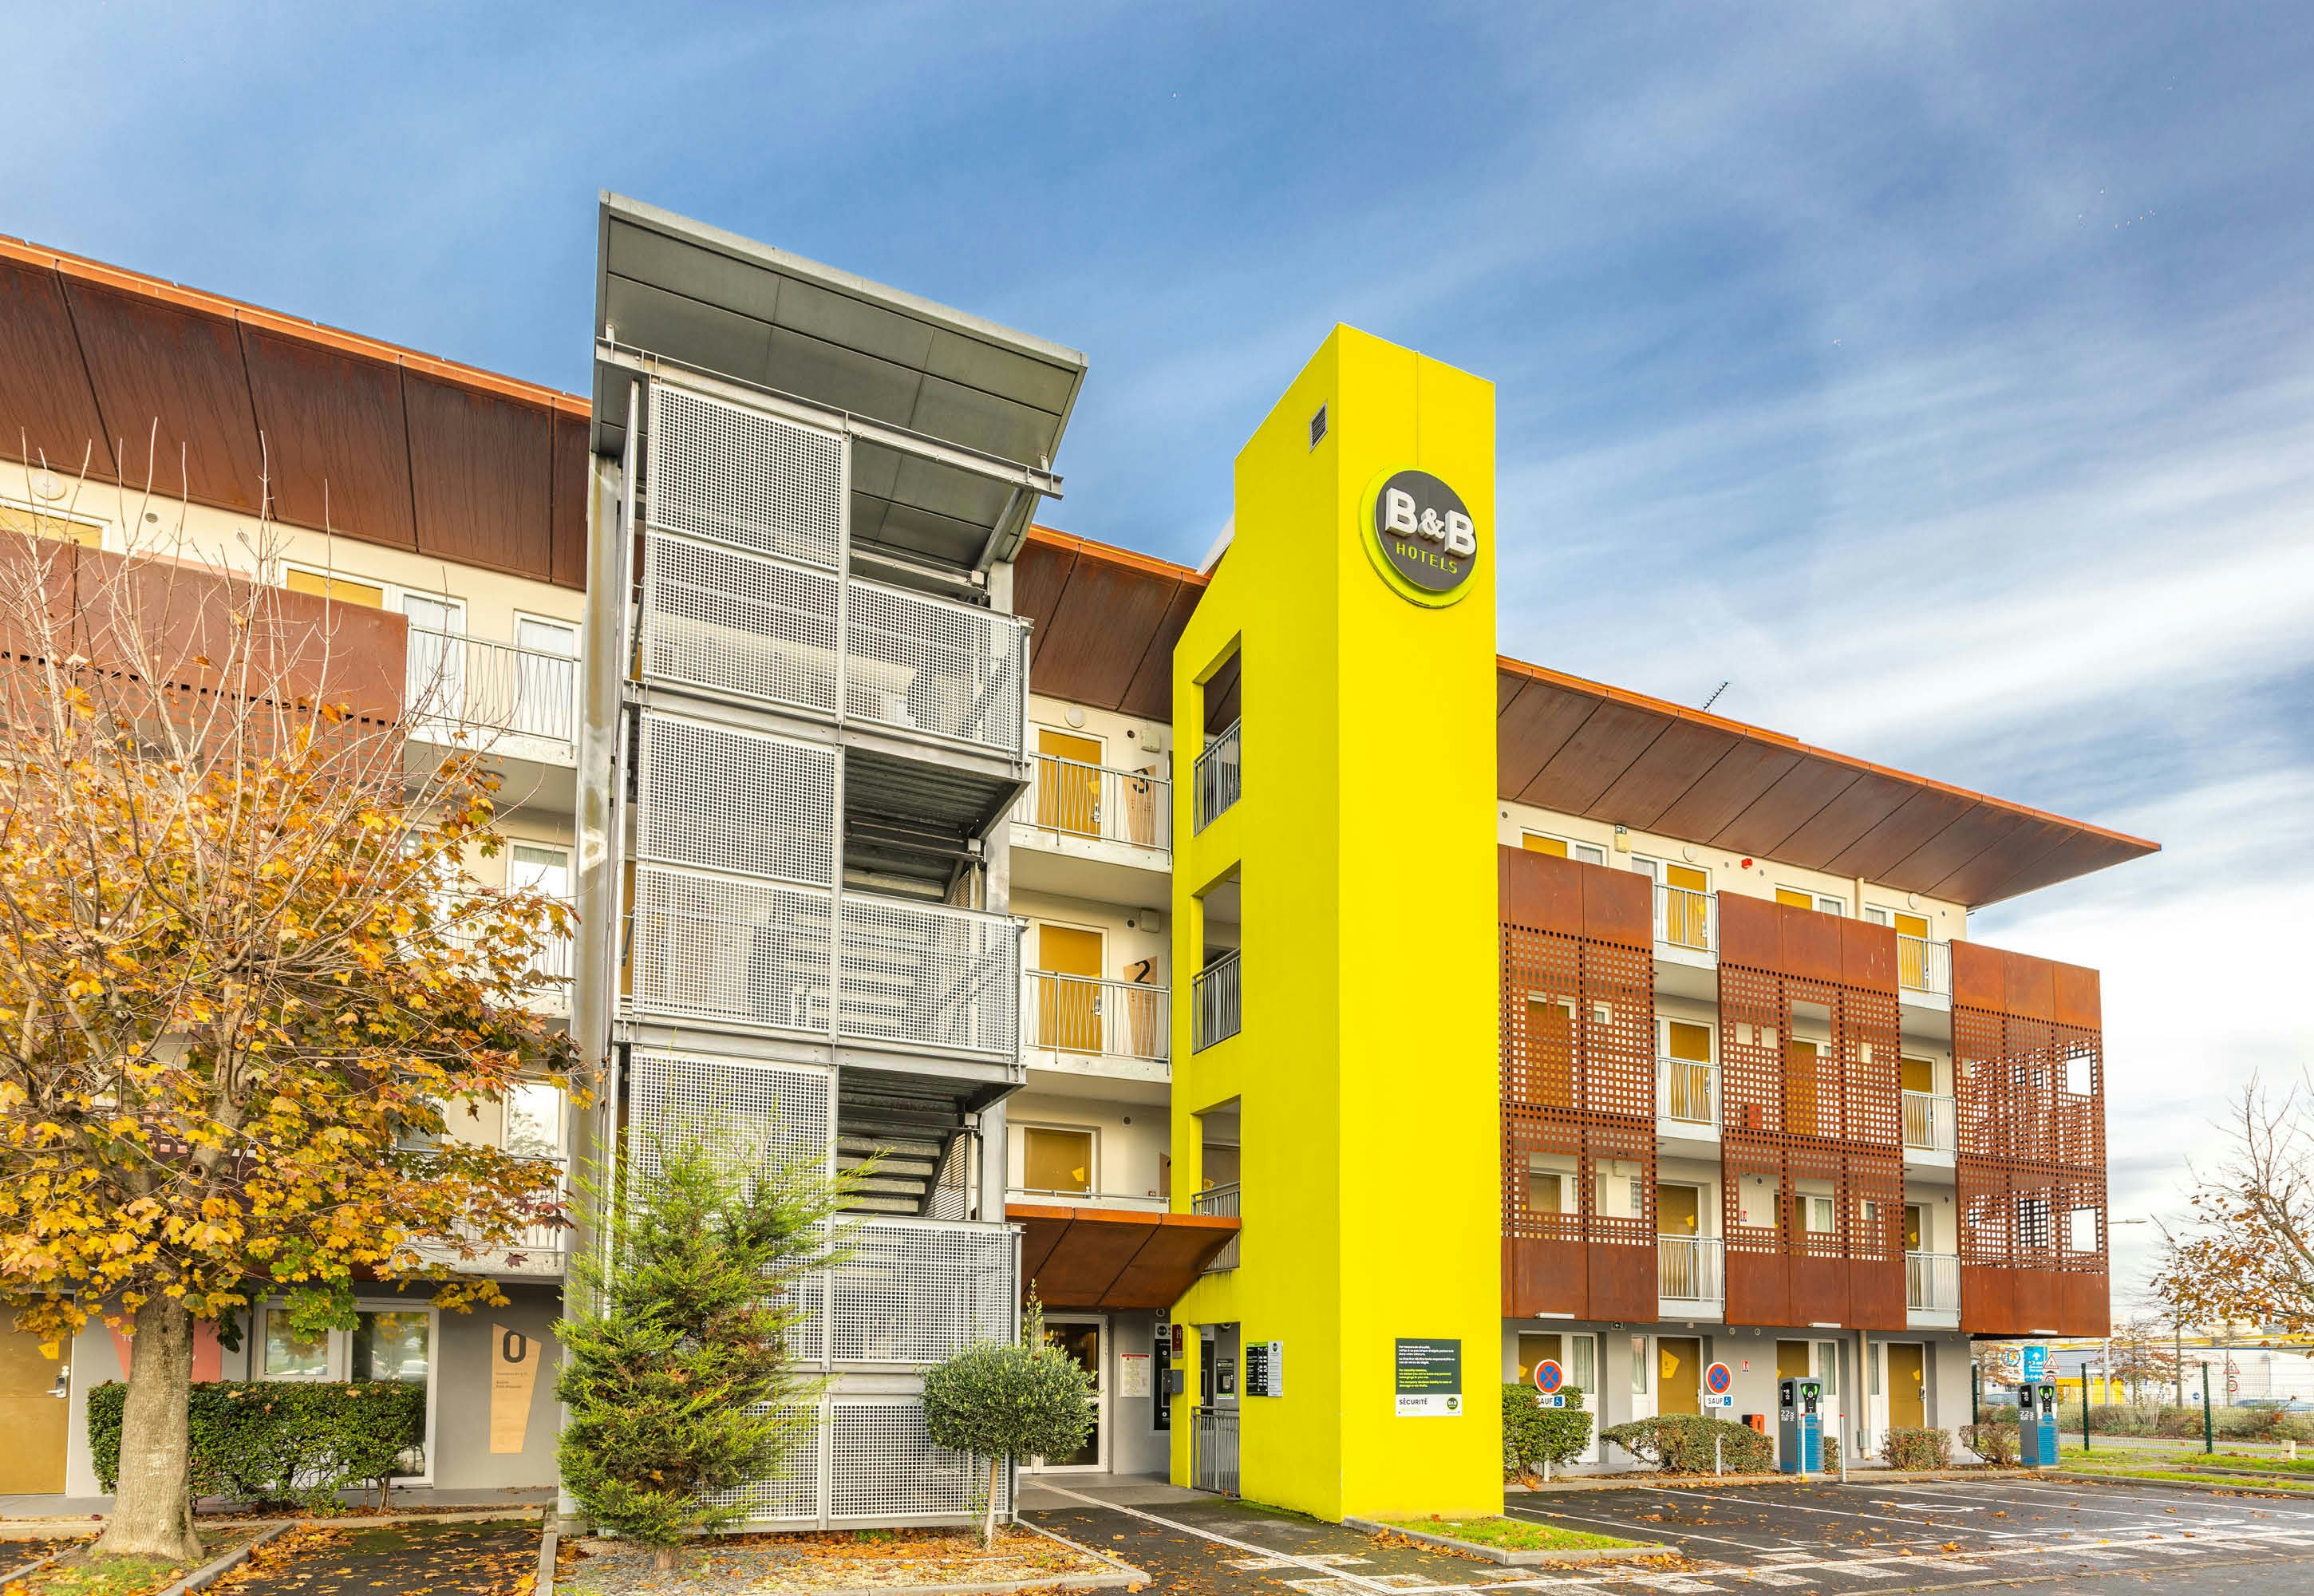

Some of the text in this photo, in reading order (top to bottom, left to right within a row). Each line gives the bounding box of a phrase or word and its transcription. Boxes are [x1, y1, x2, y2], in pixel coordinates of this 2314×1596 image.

[1385, 488, 1476, 558] B&B
[1396, 543, 1458, 574] HOTELS
[1132, 768, 1149, 794] 3
[1134, 960, 1150, 985] 2
[1177, 1329, 1181, 1339] H
